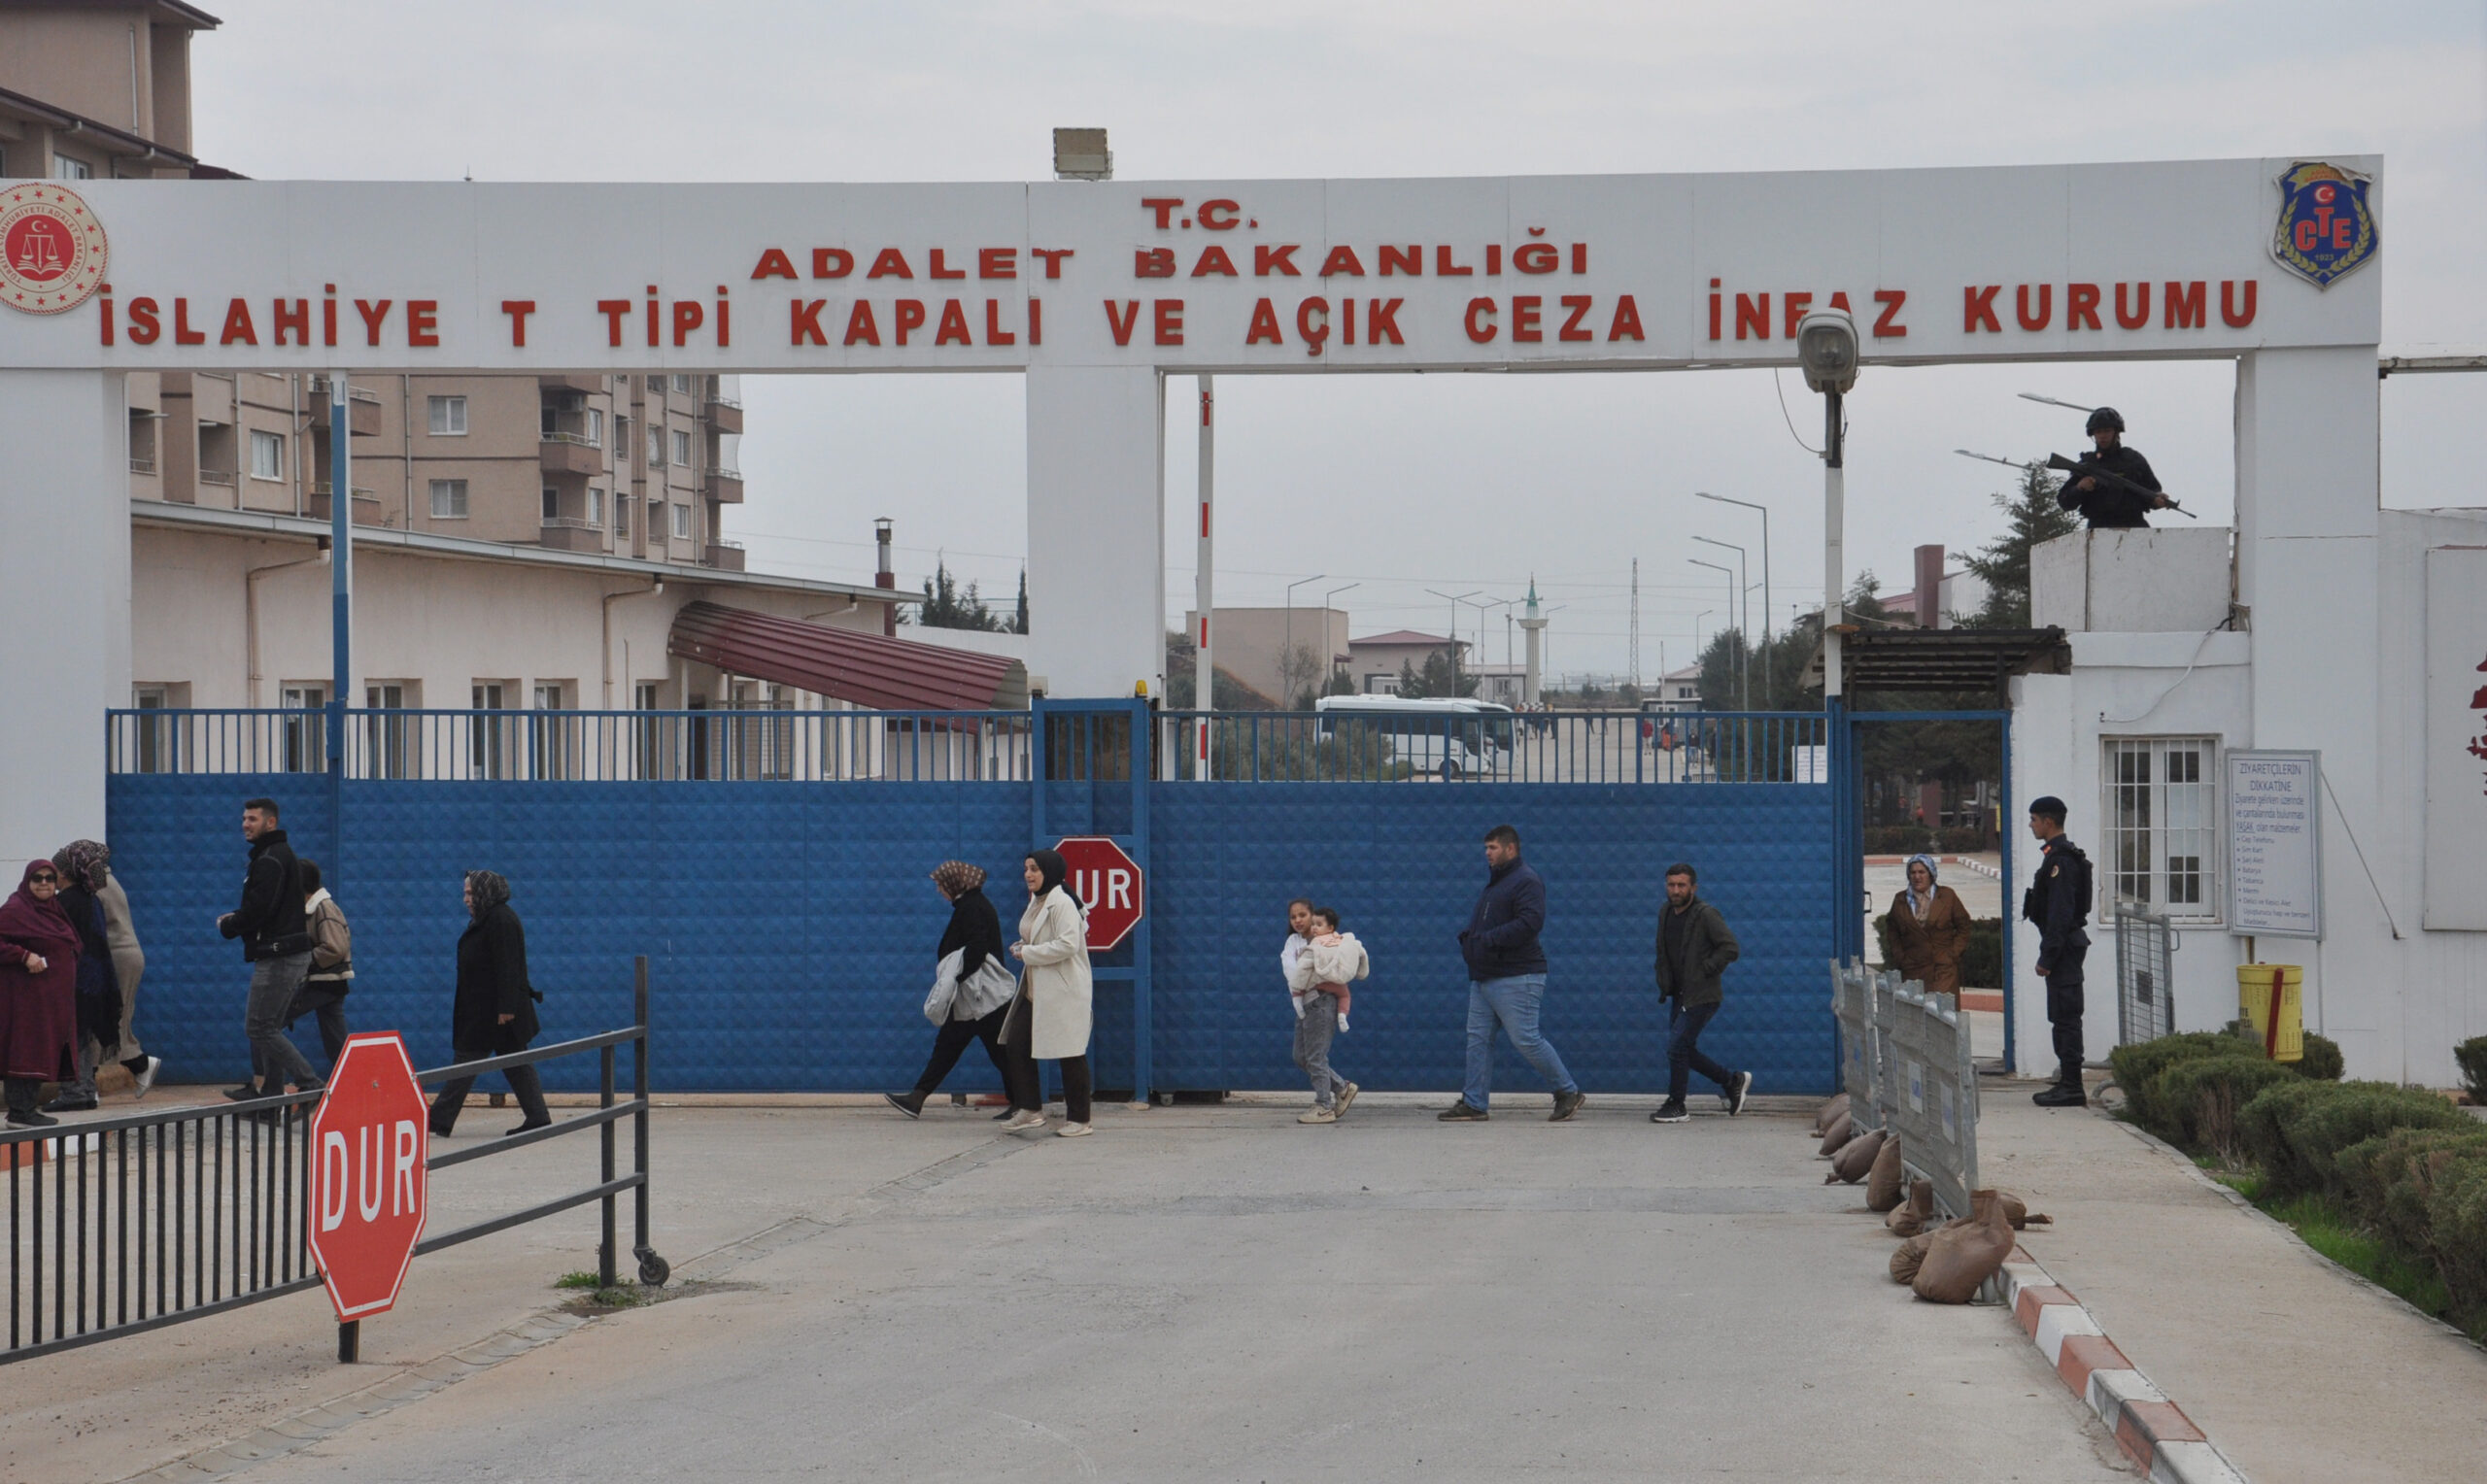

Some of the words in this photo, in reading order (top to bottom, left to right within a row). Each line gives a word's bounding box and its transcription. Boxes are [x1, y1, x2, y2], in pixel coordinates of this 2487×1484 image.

[1141, 198, 1258, 229] T.C.
[753, 248, 1074, 279] ADALET
[1136, 227, 1587, 277] BAKANLIĞI
[100, 283, 439, 346] İSLAHİYE
[502, 300, 536, 347] T
[597, 285, 730, 346] TİPİ
[791, 299, 1041, 345] KAPALI
[1105, 299, 1184, 345] VE
[1246, 296, 1405, 354] AÇIK
[1464, 294, 1646, 343] CEZA
[1965, 281, 2258, 332] KURUMU
[2239, 762, 2301, 777] ZİYARETÇİLERİN
[1075, 868, 1132, 909] UR
[322, 1120, 418, 1232] DUR
